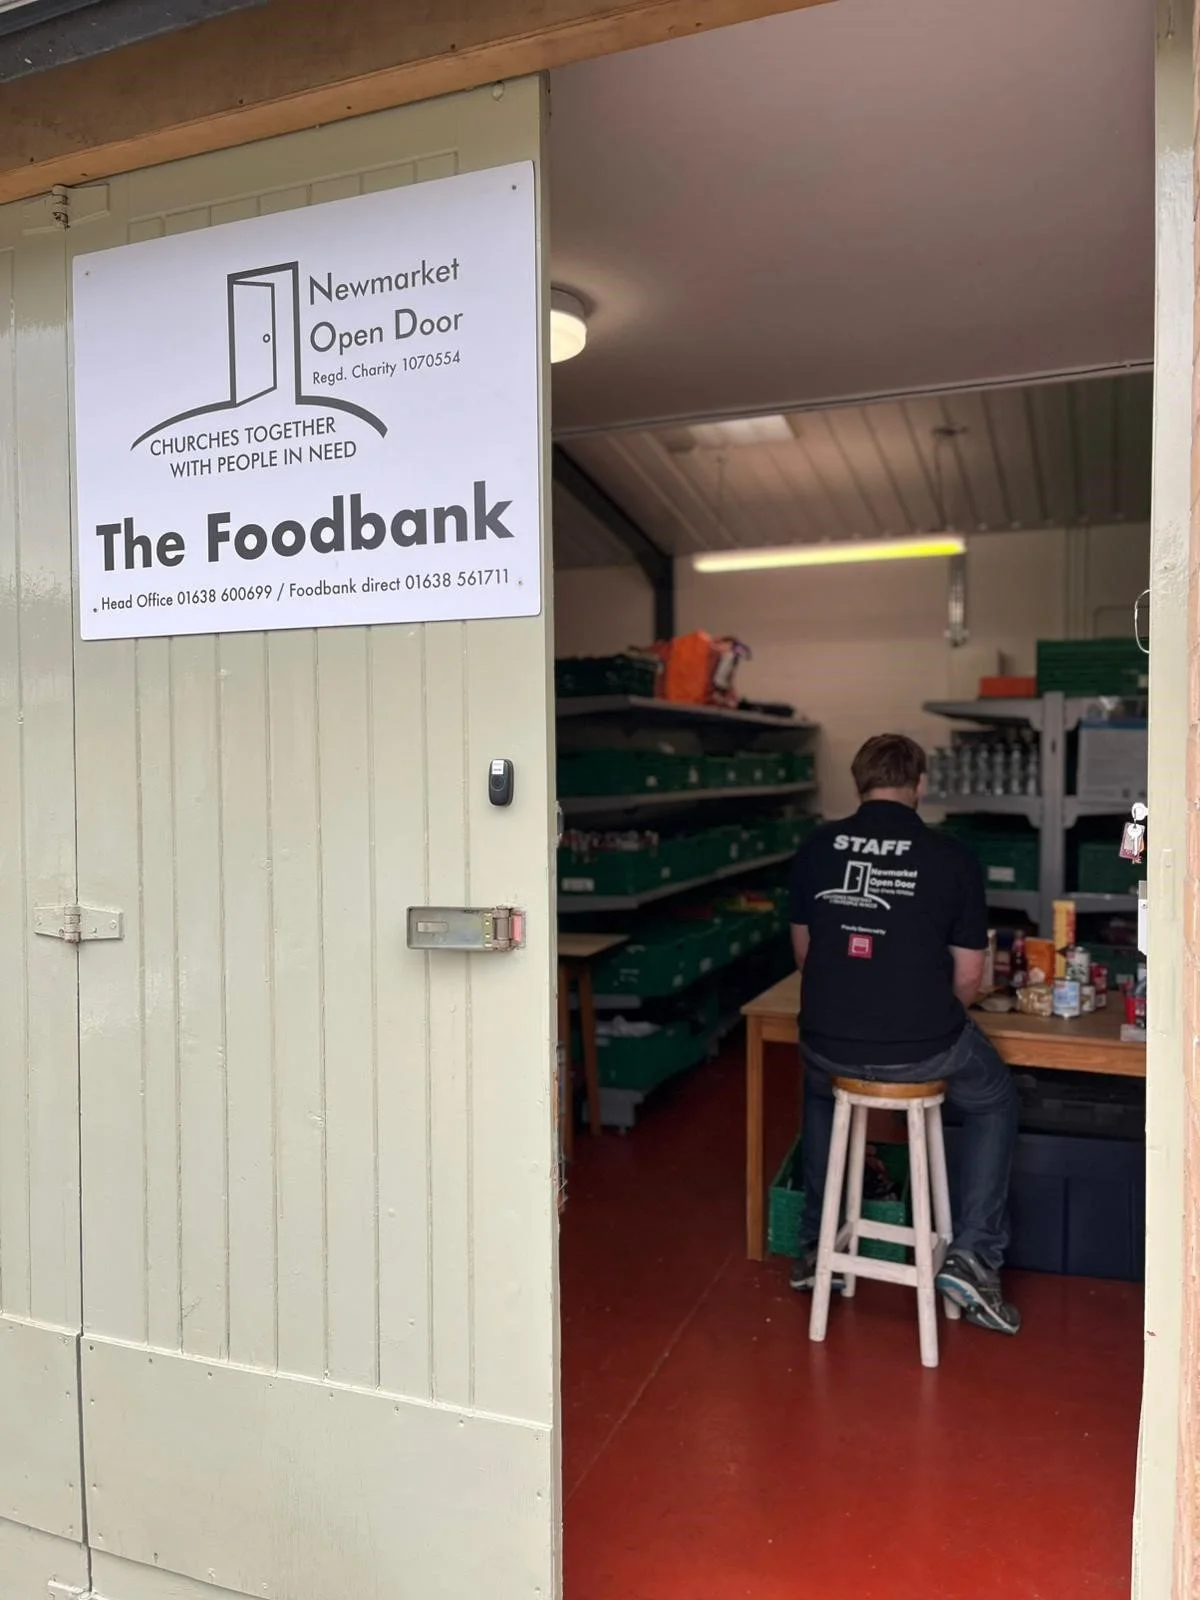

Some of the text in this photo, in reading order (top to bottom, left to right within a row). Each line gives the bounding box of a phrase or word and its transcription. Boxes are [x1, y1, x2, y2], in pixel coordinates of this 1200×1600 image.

[310, 257, 460, 305] Newmarket
[310, 308, 464, 356] Open Door
[312, 350, 461, 386] Regd. Charity 1070554
[150, 416, 337, 456] CHURCHES TOGETHER
[169, 440, 357, 478] WITH PEOPLE IN NEED
[95, 480, 515, 572] The Foodbank
[101, 568, 510, 611] Head Office 01638 600699 / Foodbank direct 01638 561711
[833, 834, 911, 855] STAFF
